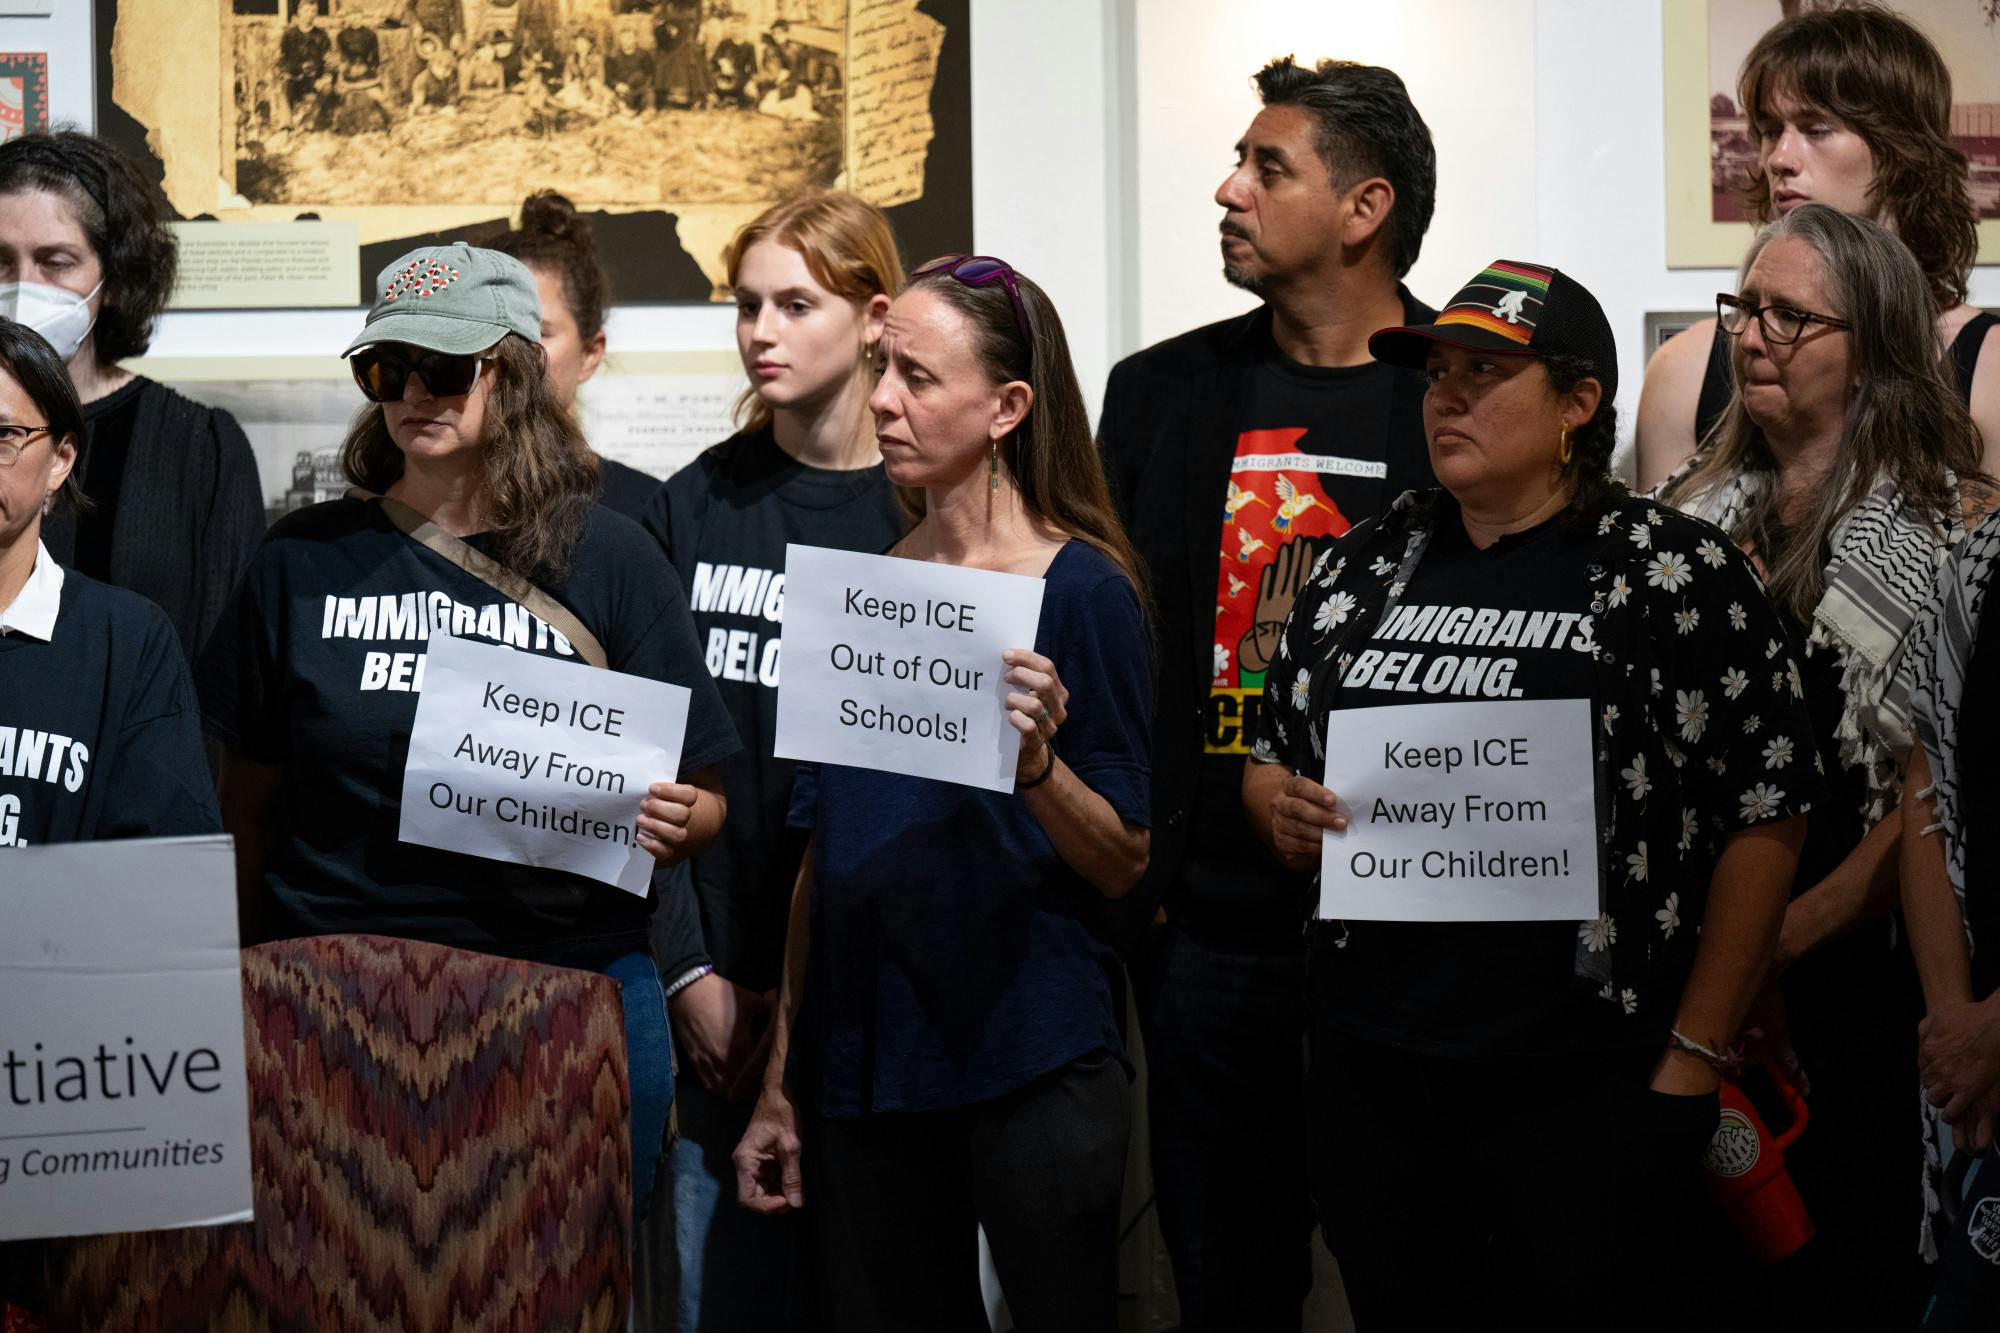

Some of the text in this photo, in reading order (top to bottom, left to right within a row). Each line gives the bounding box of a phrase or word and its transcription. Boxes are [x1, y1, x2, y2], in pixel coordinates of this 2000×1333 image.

[1316, 459, 1386, 475] WELCOME
[845, 587, 976, 632] Keep ICE
[830, 644, 984, 691] Out of Our
[1342, 649, 1523, 698] BELONG.
[483, 681, 625, 737] Keep ICE
[839, 699, 967, 744] Schools!
[453, 733, 626, 794] Away From
[1385, 738, 1529, 774] Keep ICE
[429, 782, 640, 849] Our Children!
[1370, 795, 1546, 829] Away From
[1350, 848, 1570, 879] Our Children!
[3, 1035, 222, 1107] tiative
[22, 1138, 225, 1177] Communities
